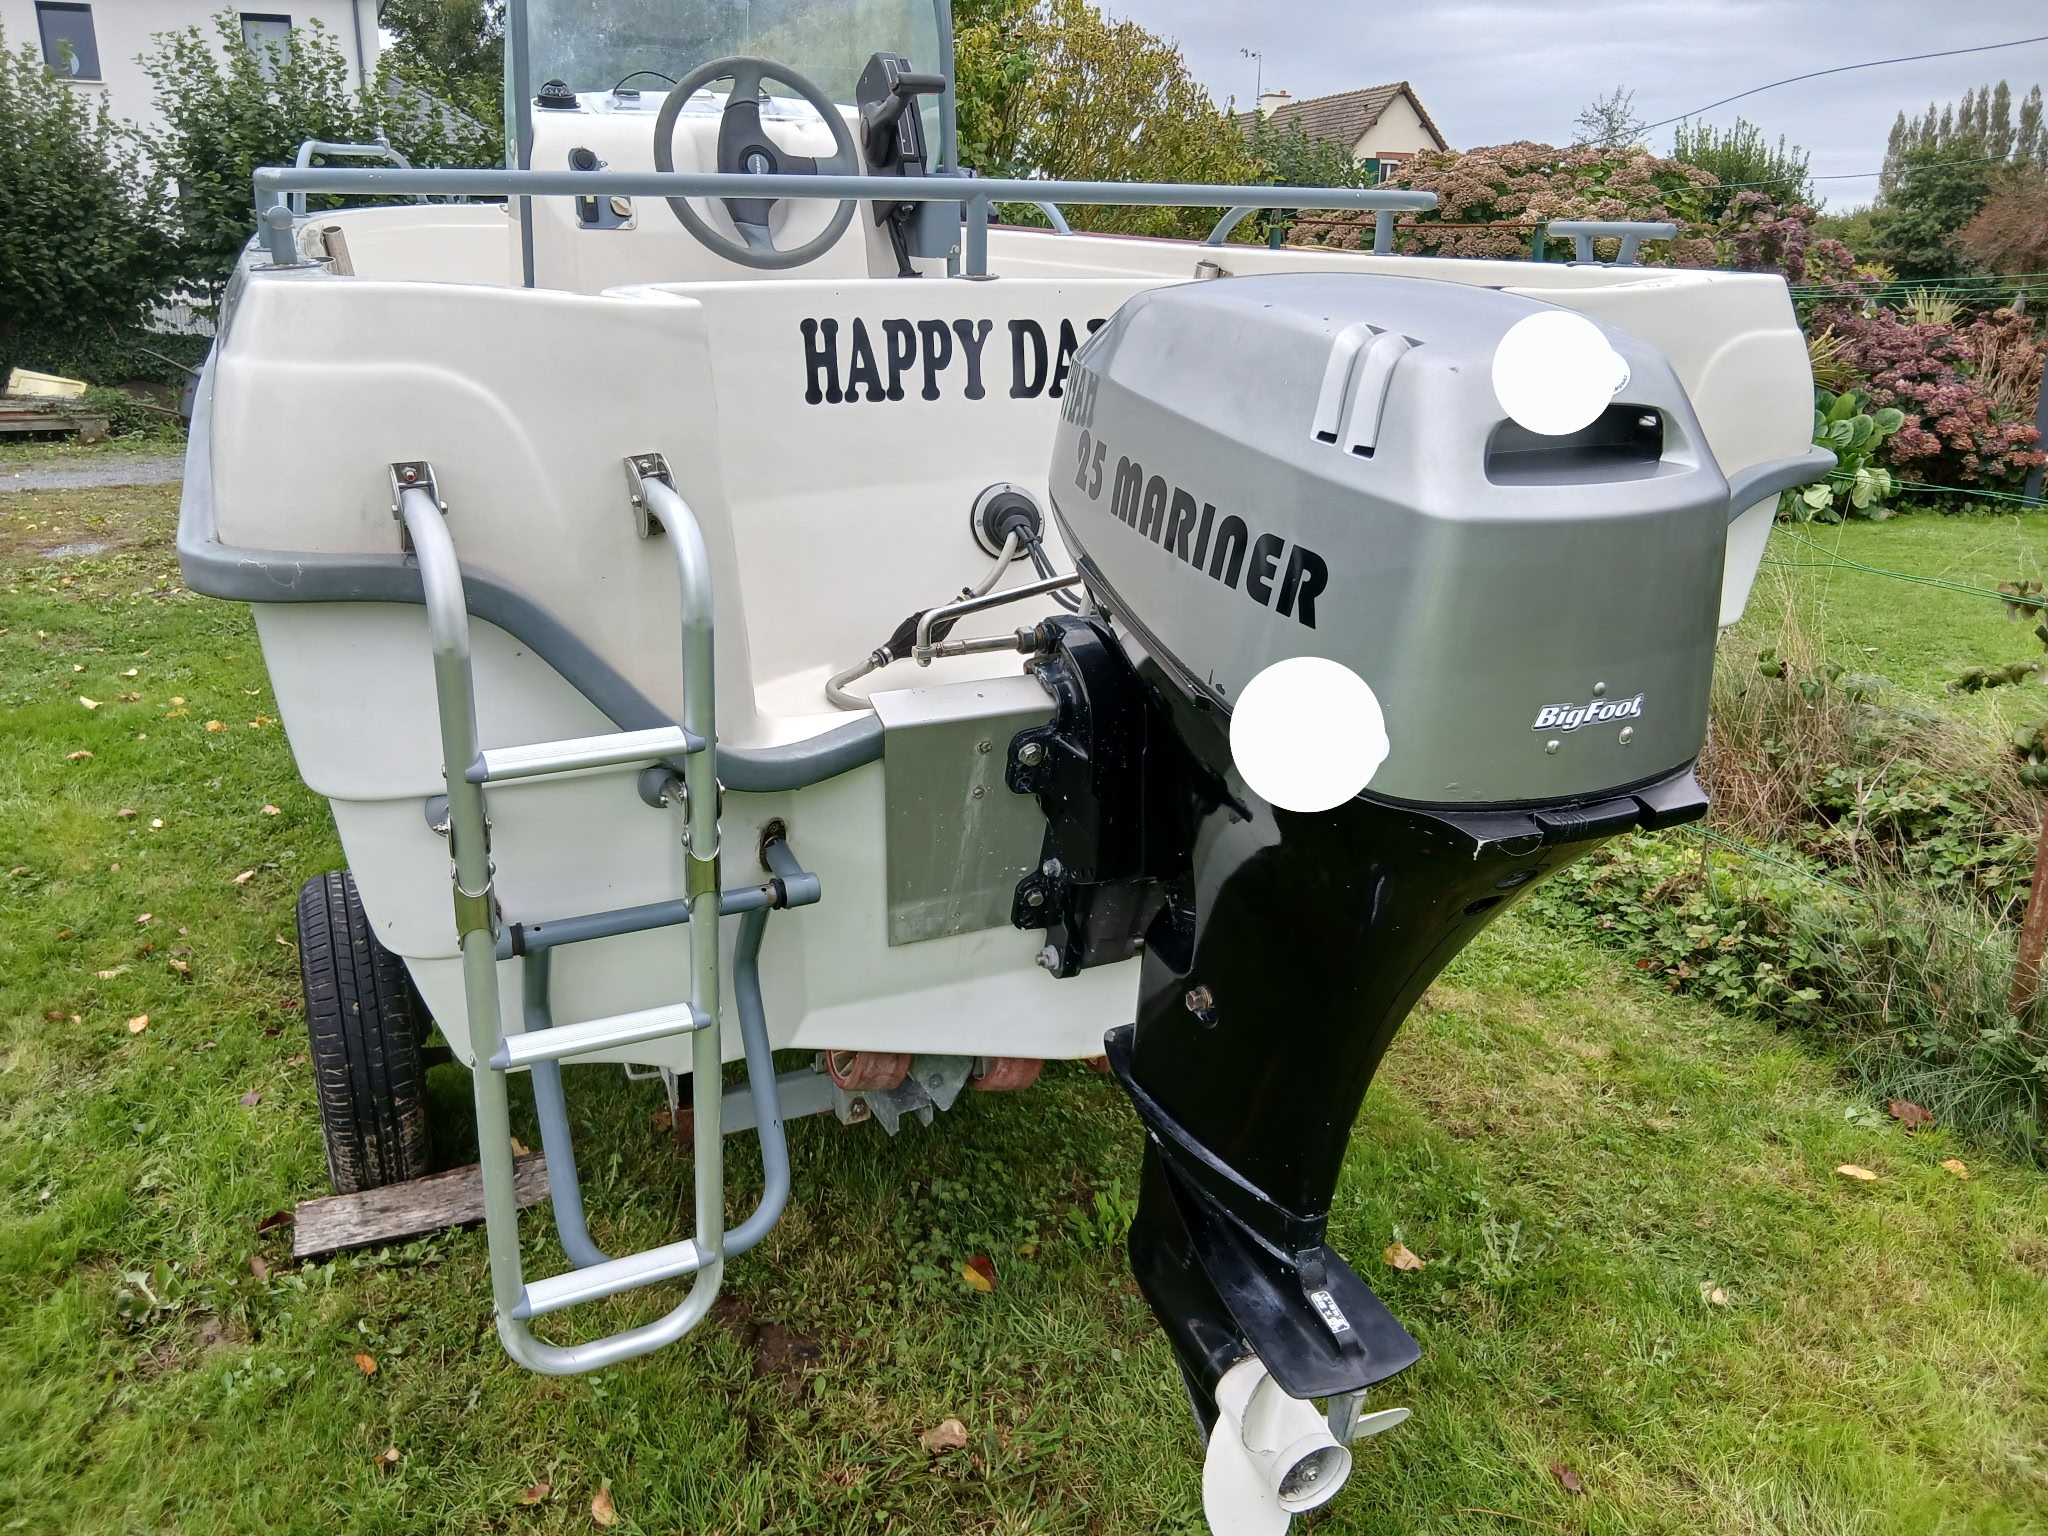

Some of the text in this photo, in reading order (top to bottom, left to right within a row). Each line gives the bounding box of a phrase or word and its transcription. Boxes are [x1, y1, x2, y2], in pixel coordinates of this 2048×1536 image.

[800, 317, 993, 404] HAPPY
[1008, 318, 1108, 399] DA
[1075, 429, 1329, 629] 25 MARINER
[1533, 694, 1643, 731] BigFoot
